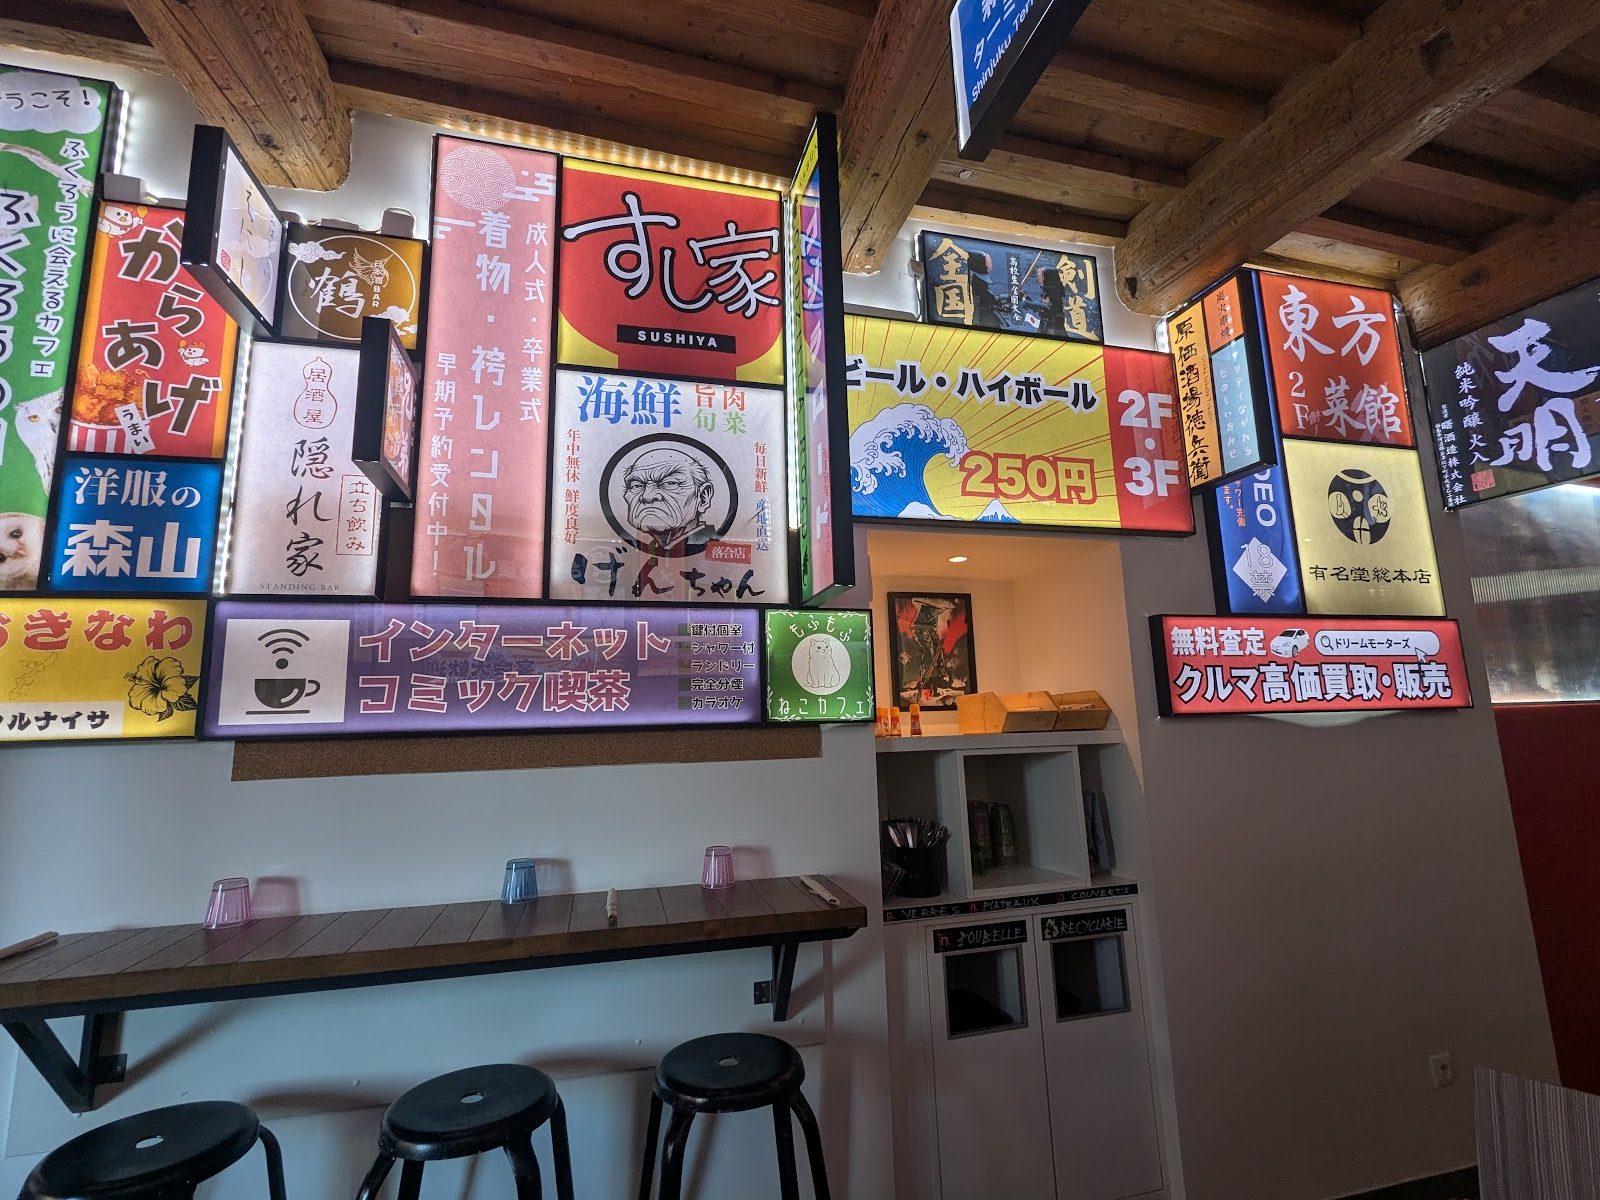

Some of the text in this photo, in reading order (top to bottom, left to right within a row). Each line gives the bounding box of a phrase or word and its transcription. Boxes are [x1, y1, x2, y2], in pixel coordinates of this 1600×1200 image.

[972, 33, 1011, 102] Shinjuku
[1013, 0, 1034, 32] Ter
[0, 89, 91, 110] うこそ!
[561, 190, 781, 319] すし家
[308, 266, 366, 319] 鶴
[928, 237, 975, 326] 全国
[1008, 255, 1024, 323] 高校生全国大会
[101, 216, 222, 437] からあげ
[519, 222, 548, 424] 成人式・卒業式
[637, 330, 718, 349] SUSHIYA
[1278, 284, 1387, 367] 東方
[303, 367, 328, 425] 居酒屋
[577, 374, 683, 429] 海鮮
[846, 357, 1098, 411] ビール・ハイボール
[1174, 315, 1211, 482] 原価酒場徳兵衛
[1321, 375, 1402, 440] 菜館
[1487, 317, 1600, 473] 天明
[122, 408, 150, 447] うまい
[75, 467, 202, 508] 洋服の
[563, 428, 581, 545] 年中無休 鮮度良好
[753, 441, 769, 494] 毎日新鮮
[959, 450, 1097, 505] 250円
[285, 436, 335, 578] 隠れ家
[346, 480, 371, 551] 立ち飲み
[61, 519, 202, 579] 森山
[570, 546, 766, 599] げんちゃん
[711, 545, 746, 560] 落合店
[259, 582, 340, 592] STANDING BAR
[1249, 569, 1275, 597] 禁
[1308, 564, 1432, 585] 有名堂総本店
[359, 618, 671, 663] インターネット
[690, 623, 743, 637] 鍵付個室
[690, 641, 756, 655] シャワー付
[1170, 626, 1267, 657] 無料査定
[1334, 637, 1411, 650] ドリームモーターズ
[690, 659, 756, 673] ランドリー
[690, 677, 744, 691] 完全分煙
[1174, 661, 1452, 704] クルマ高価買取・販売
[359, 669, 632, 714] コミック喫茶
[691, 696, 743, 710] カラオケ
[779, 697, 865, 715] ねこカフェ
[0, 710, 110, 731] ルナイサ
[901, 905, 961, 920] VERRES
[981, 896, 1041, 912] PLATEAUX
